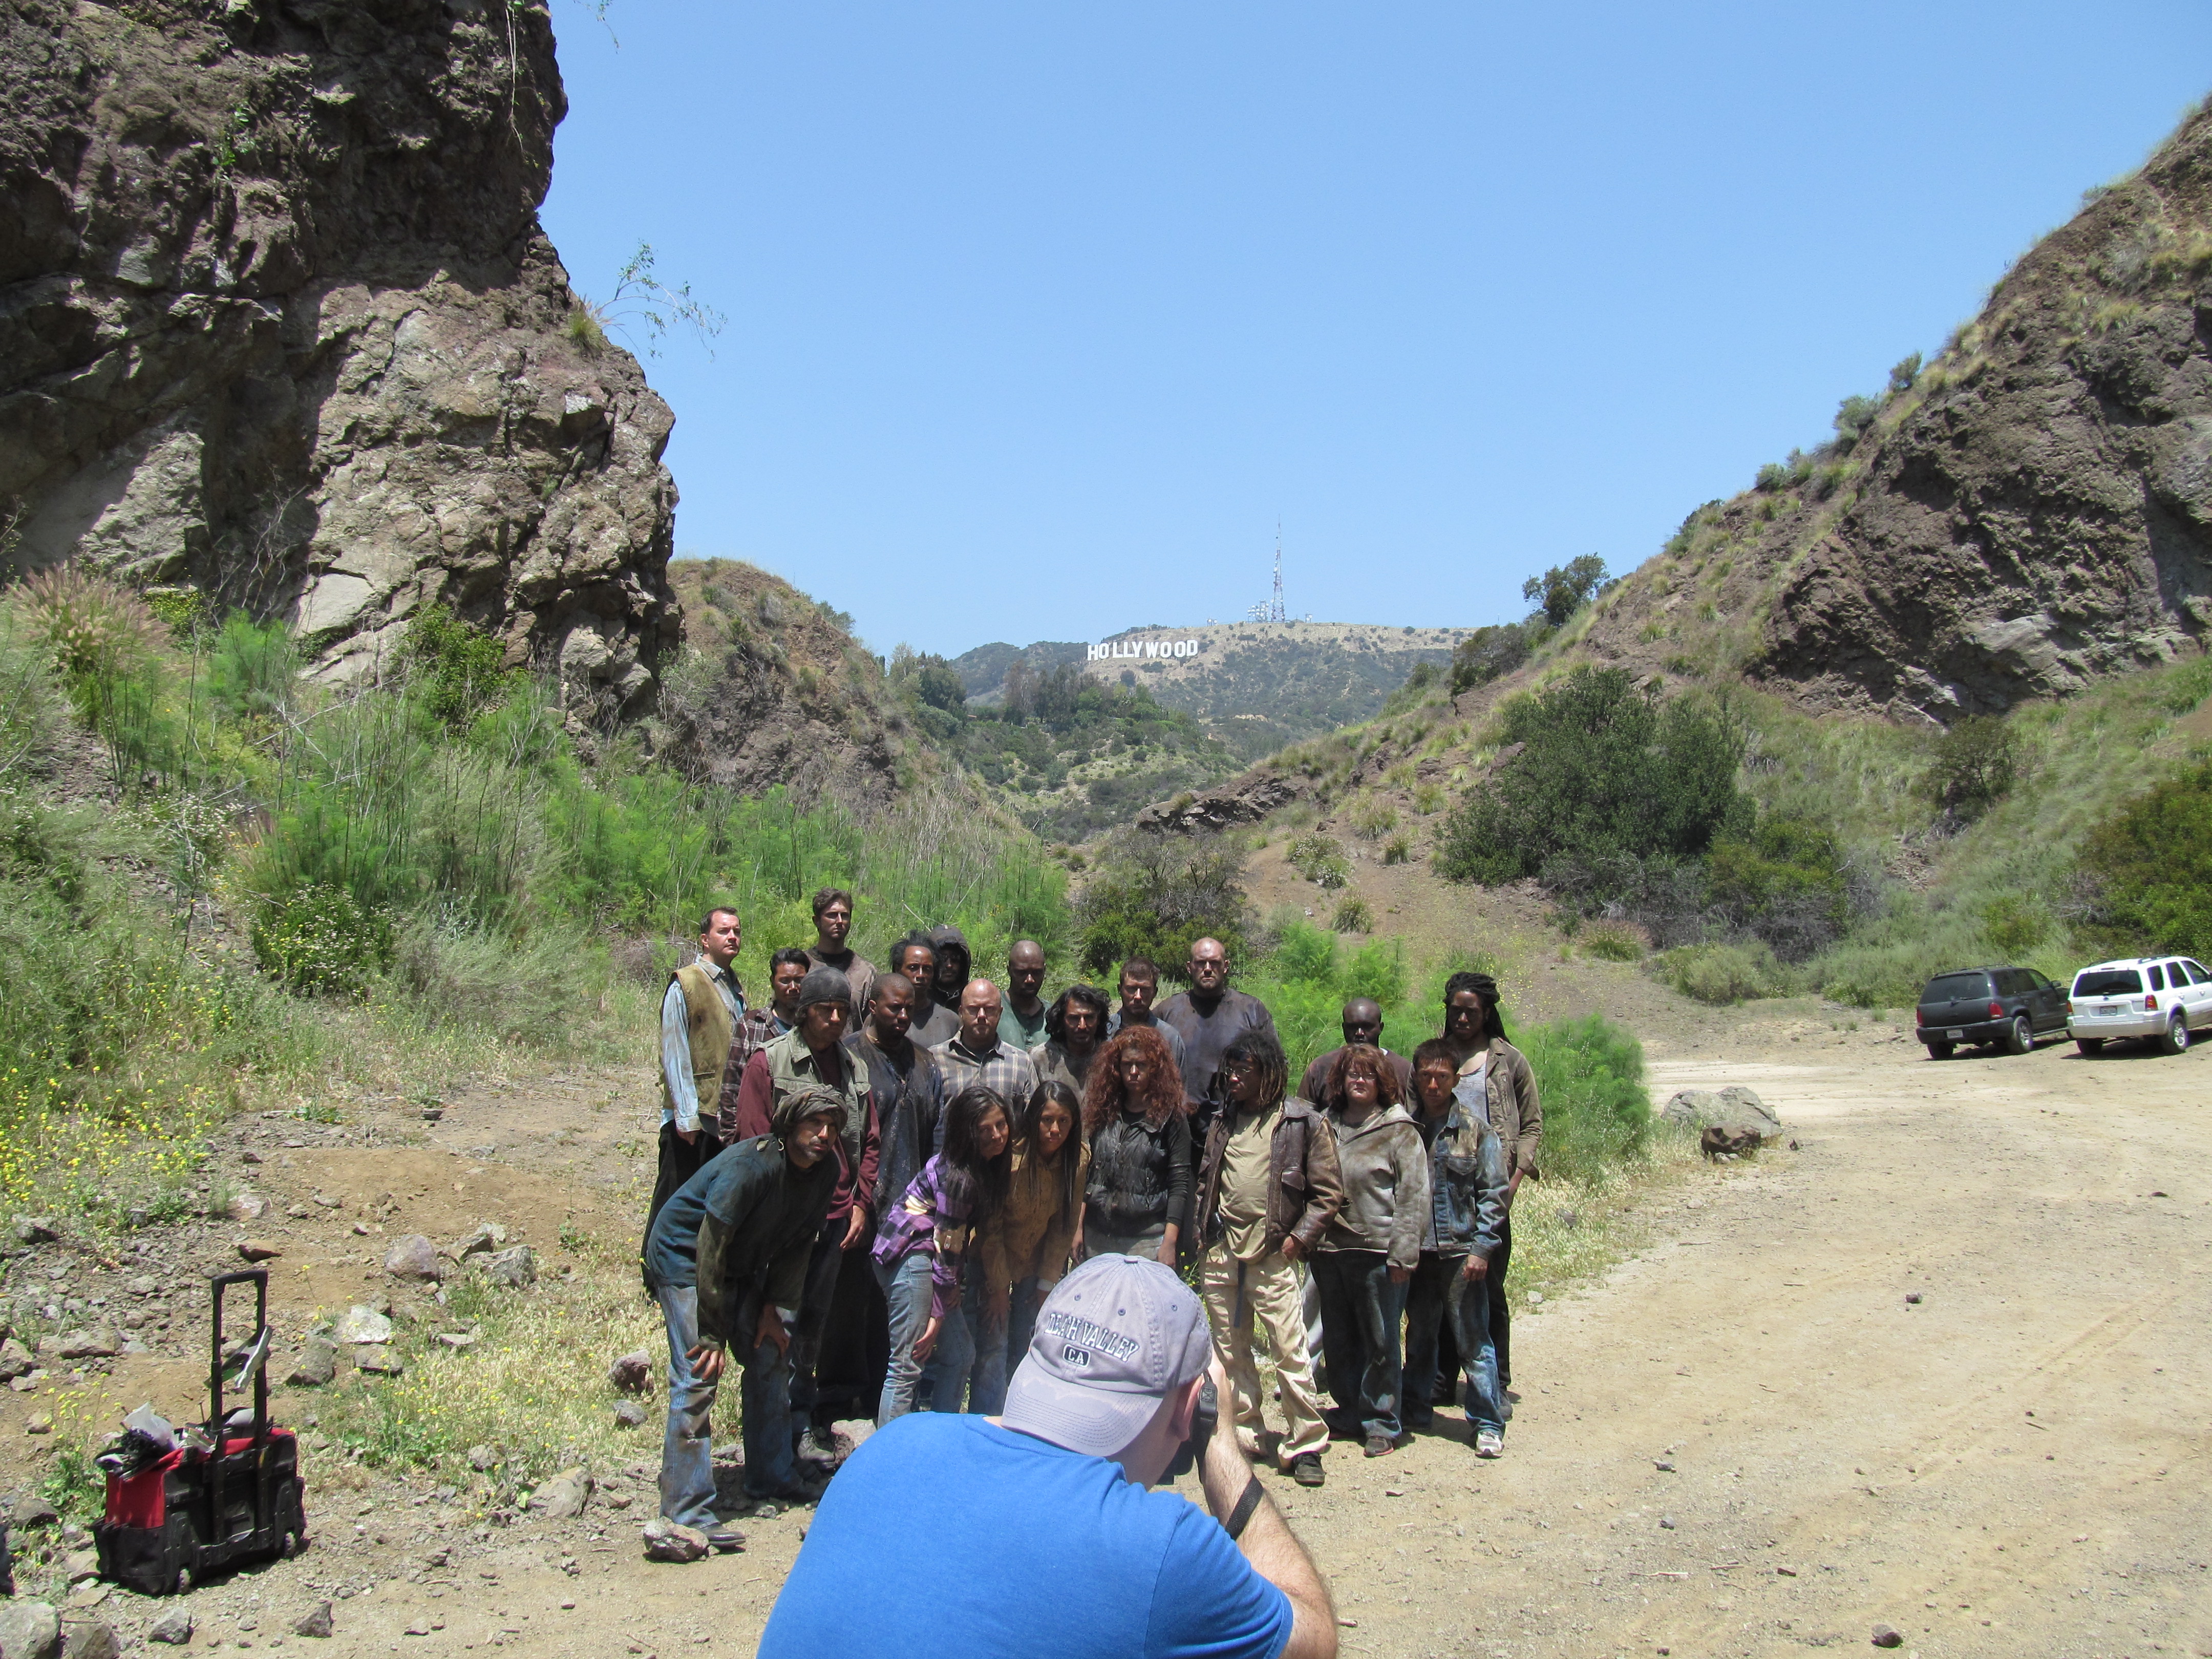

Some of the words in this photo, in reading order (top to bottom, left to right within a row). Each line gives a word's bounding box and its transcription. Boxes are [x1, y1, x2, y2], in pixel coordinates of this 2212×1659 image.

[1087, 640, 1198, 661] HOLLYWOOD
[1081, 1322, 1140, 1362] VALLEY
[1068, 1348, 1084, 1364] CA
